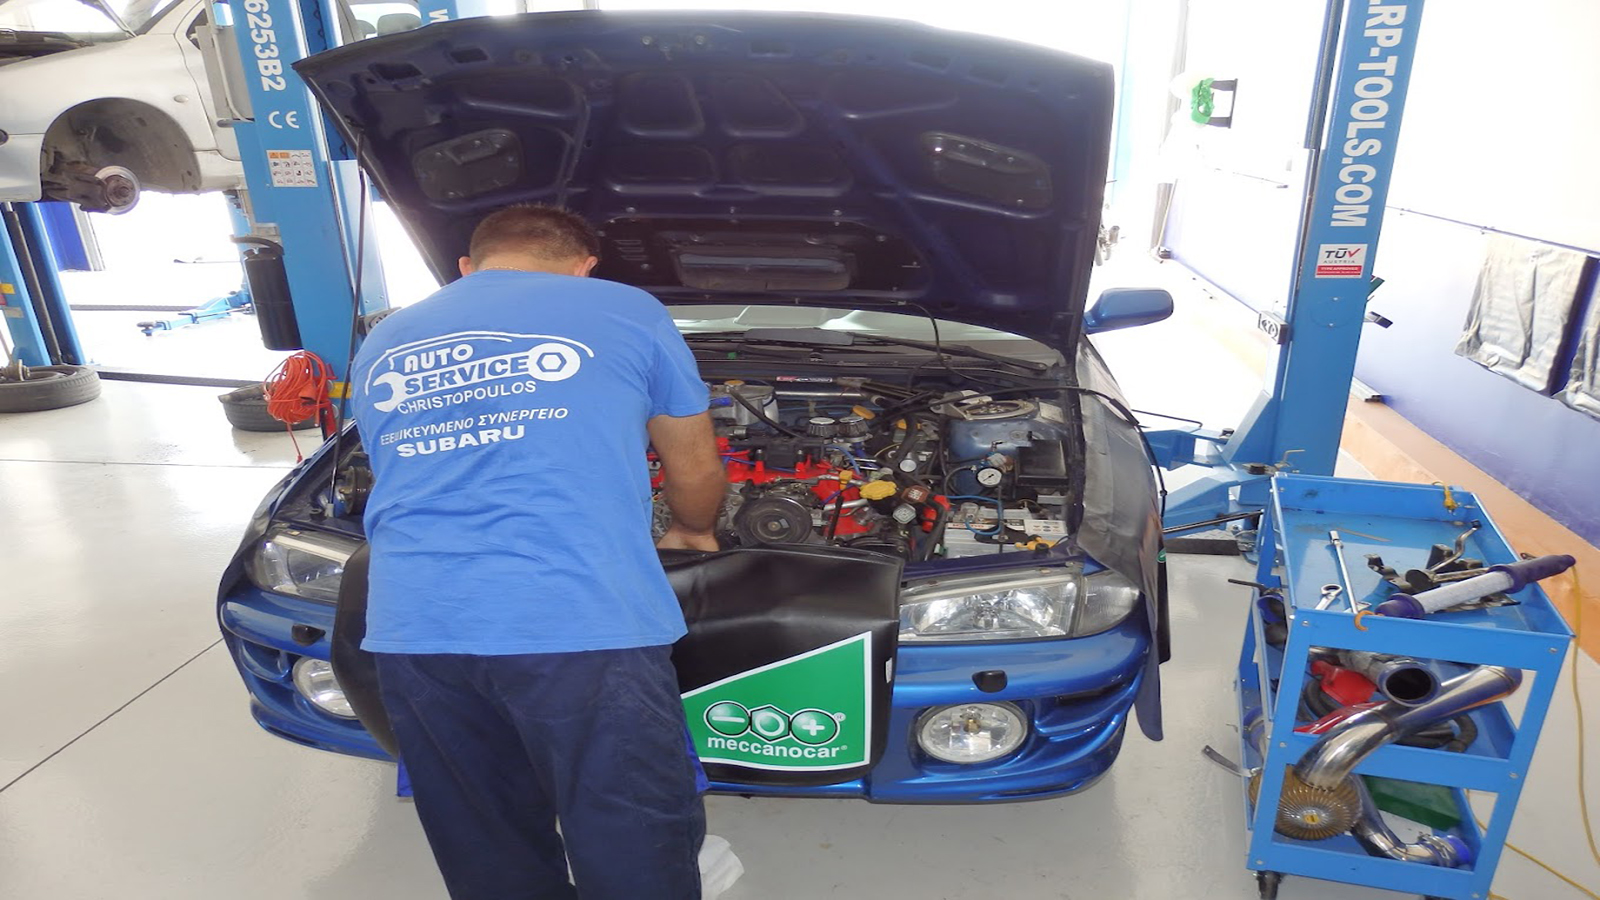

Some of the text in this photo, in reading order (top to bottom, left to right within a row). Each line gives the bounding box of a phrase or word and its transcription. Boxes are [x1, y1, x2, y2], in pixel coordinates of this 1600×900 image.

[404, 344, 473, 372] AUTO
[404, 355, 530, 396] SERVICE
[397, 380, 536, 415] CHRISTOPOULOS
[477, 407, 569, 427] ΣΥΝΕΡΓΕΙΟ
[396, 425, 525, 458] SUBARU
[707, 736, 839, 758] meccanocar
